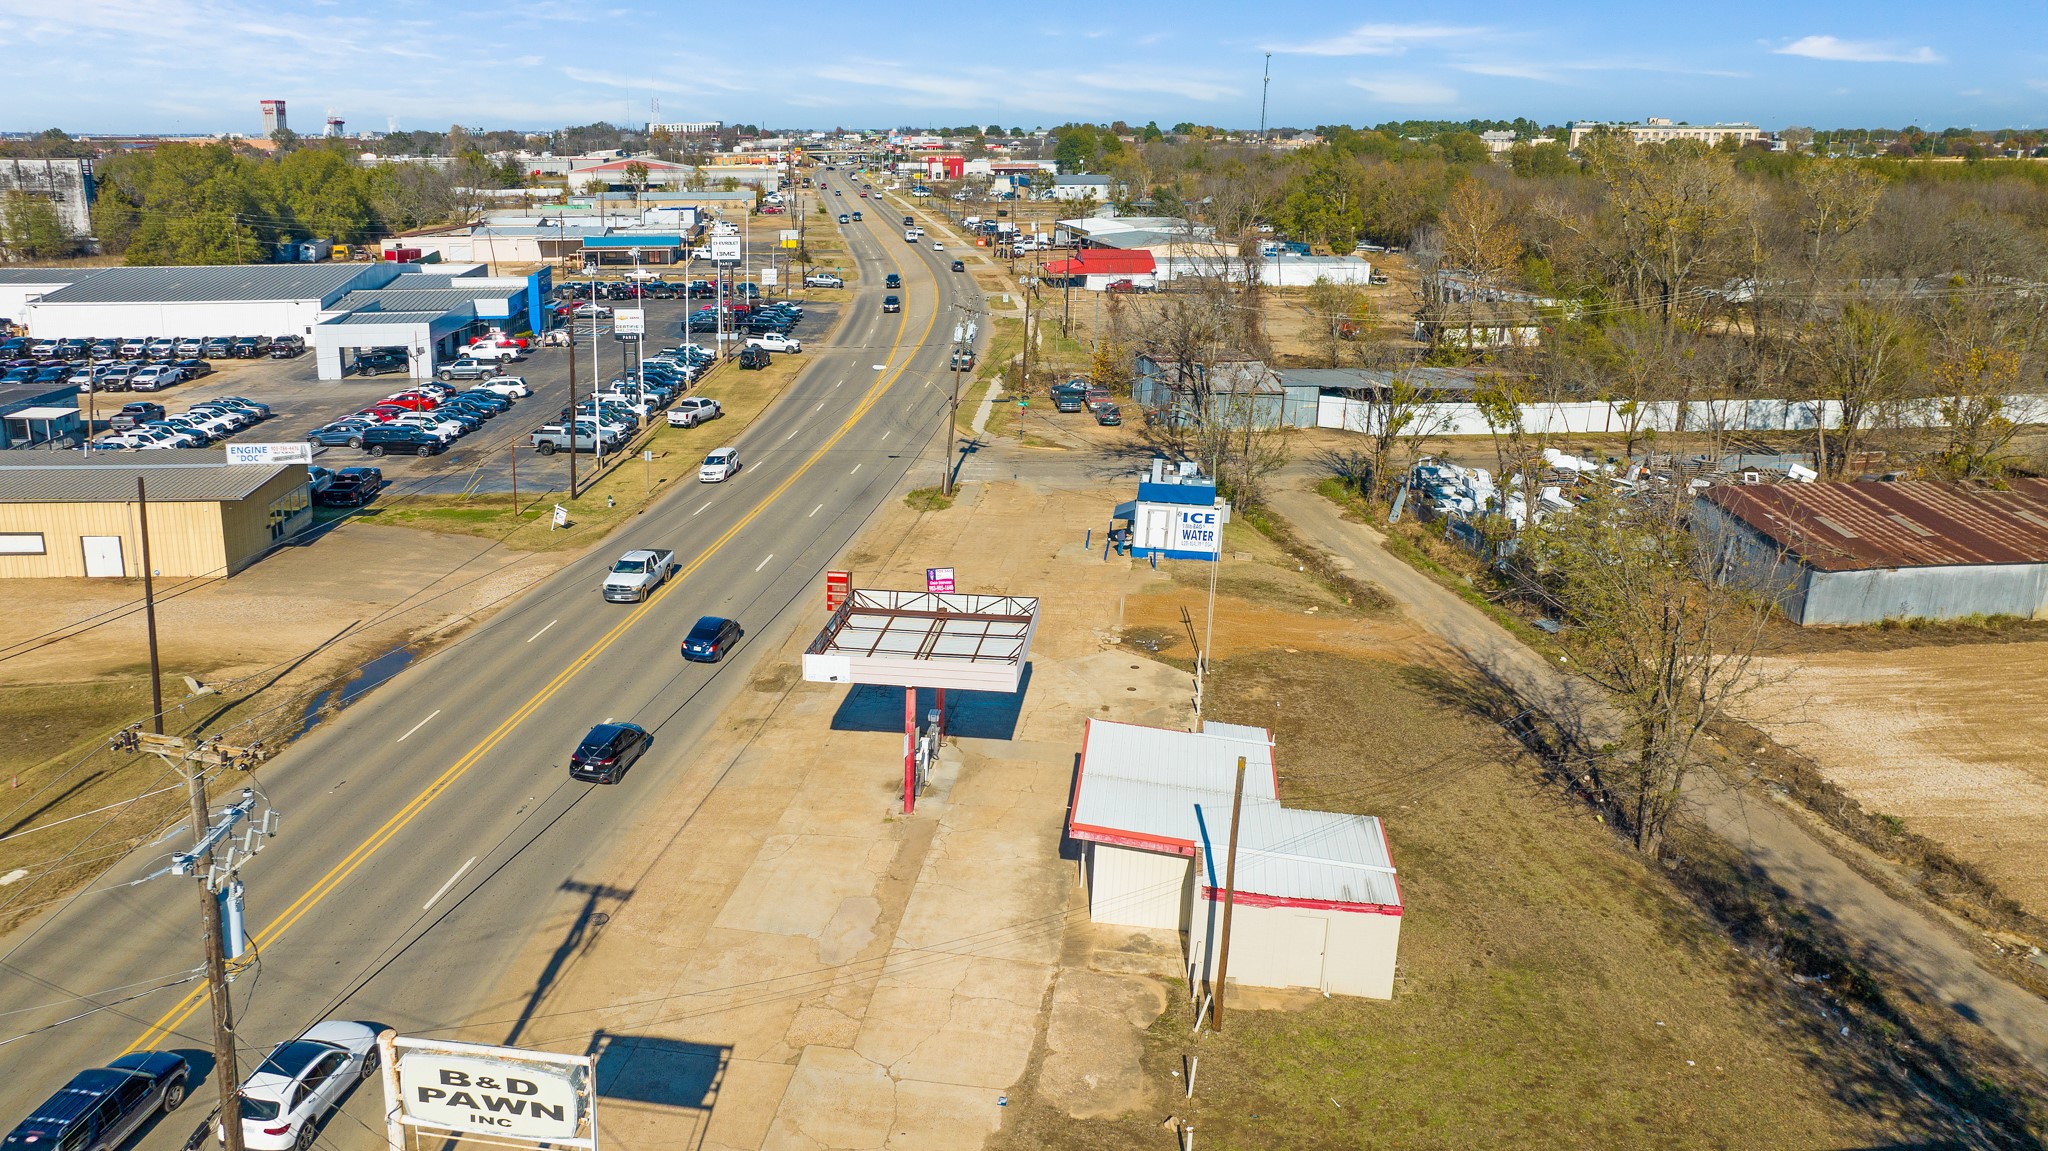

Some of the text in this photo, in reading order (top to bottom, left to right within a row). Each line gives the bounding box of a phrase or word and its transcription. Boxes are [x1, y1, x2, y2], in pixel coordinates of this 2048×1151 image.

[230, 446, 268, 454] ENGINE
[1182, 512, 1215, 524] ICE
[1182, 529, 1214, 541] WATER
[439, 1068, 539, 1096] B&D
[417, 1086, 565, 1122] PAWN
[470, 1114, 513, 1128] INC
